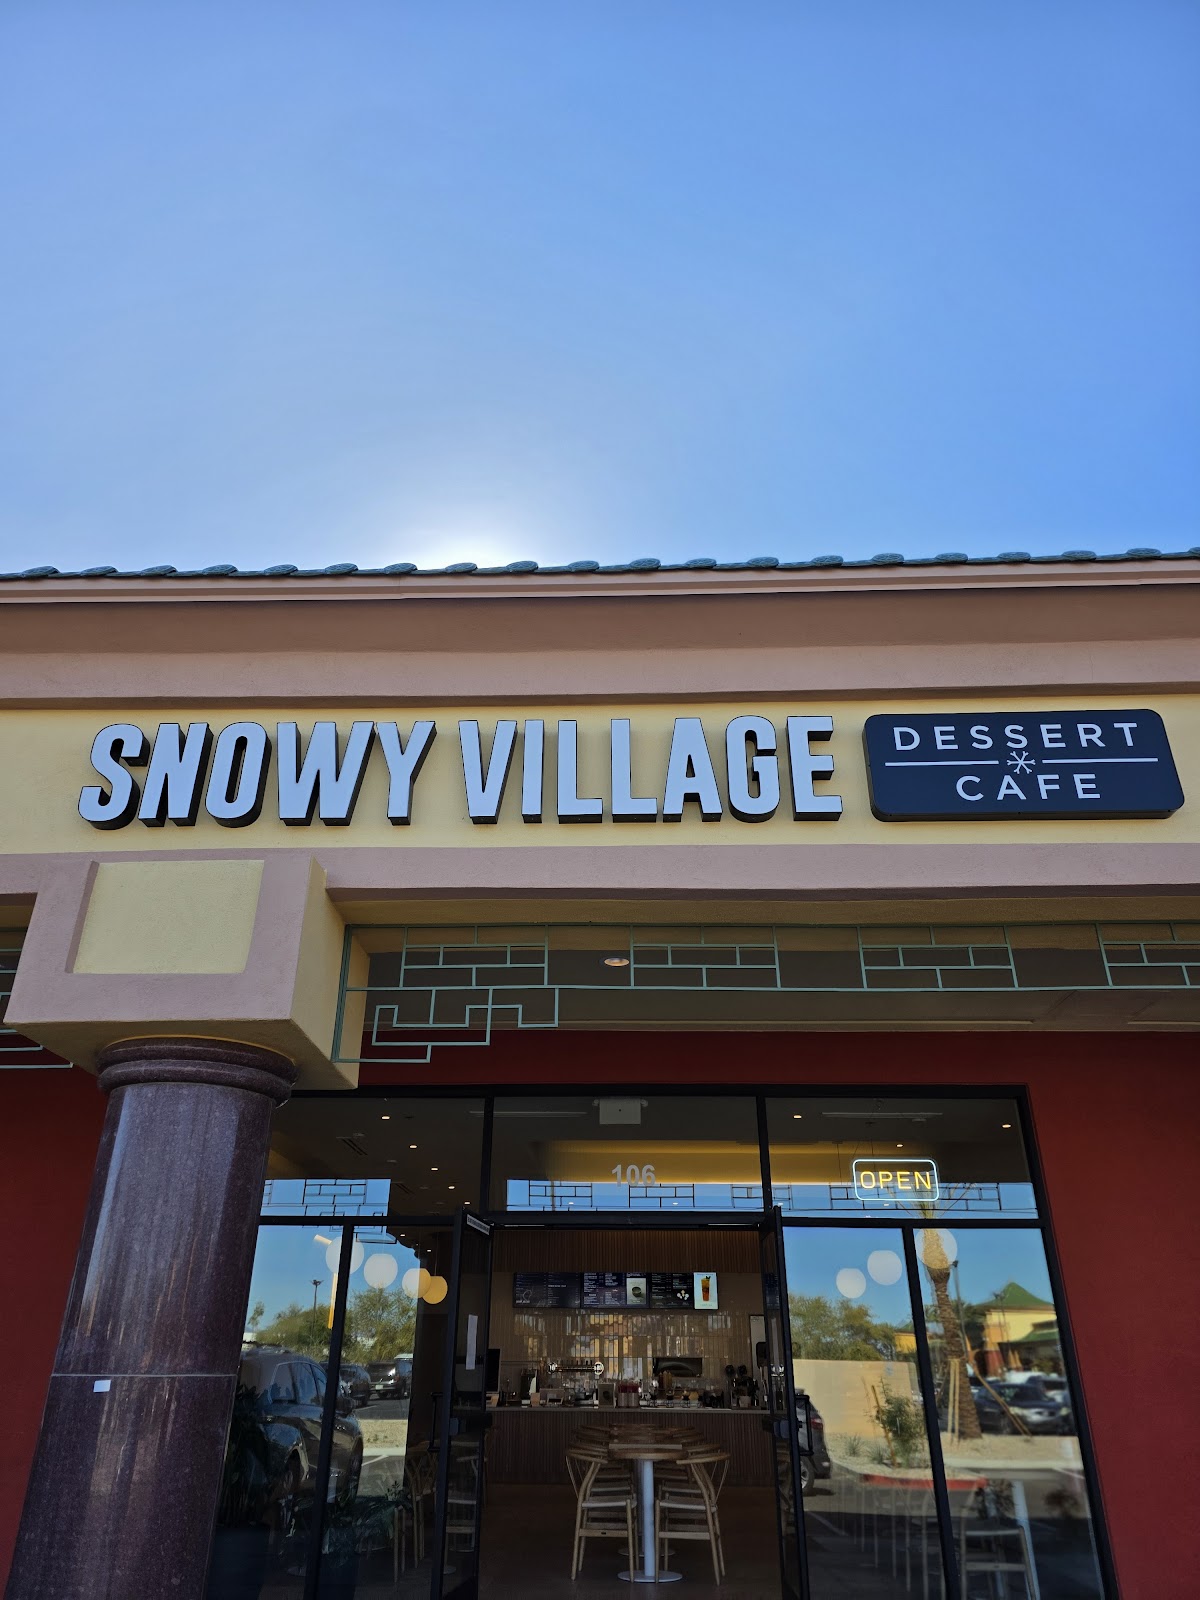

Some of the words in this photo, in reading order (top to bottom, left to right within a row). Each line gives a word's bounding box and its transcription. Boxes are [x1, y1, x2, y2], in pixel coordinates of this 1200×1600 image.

[893, 722, 1138, 751] DESSERT
[78, 721, 436, 829] SNOWY
[458, 715, 843, 824] VILLAGE
[955, 773, 1101, 801] CAFE
[611, 1164, 656, 1187] 106
[860, 1171, 932, 1190] OPEN
